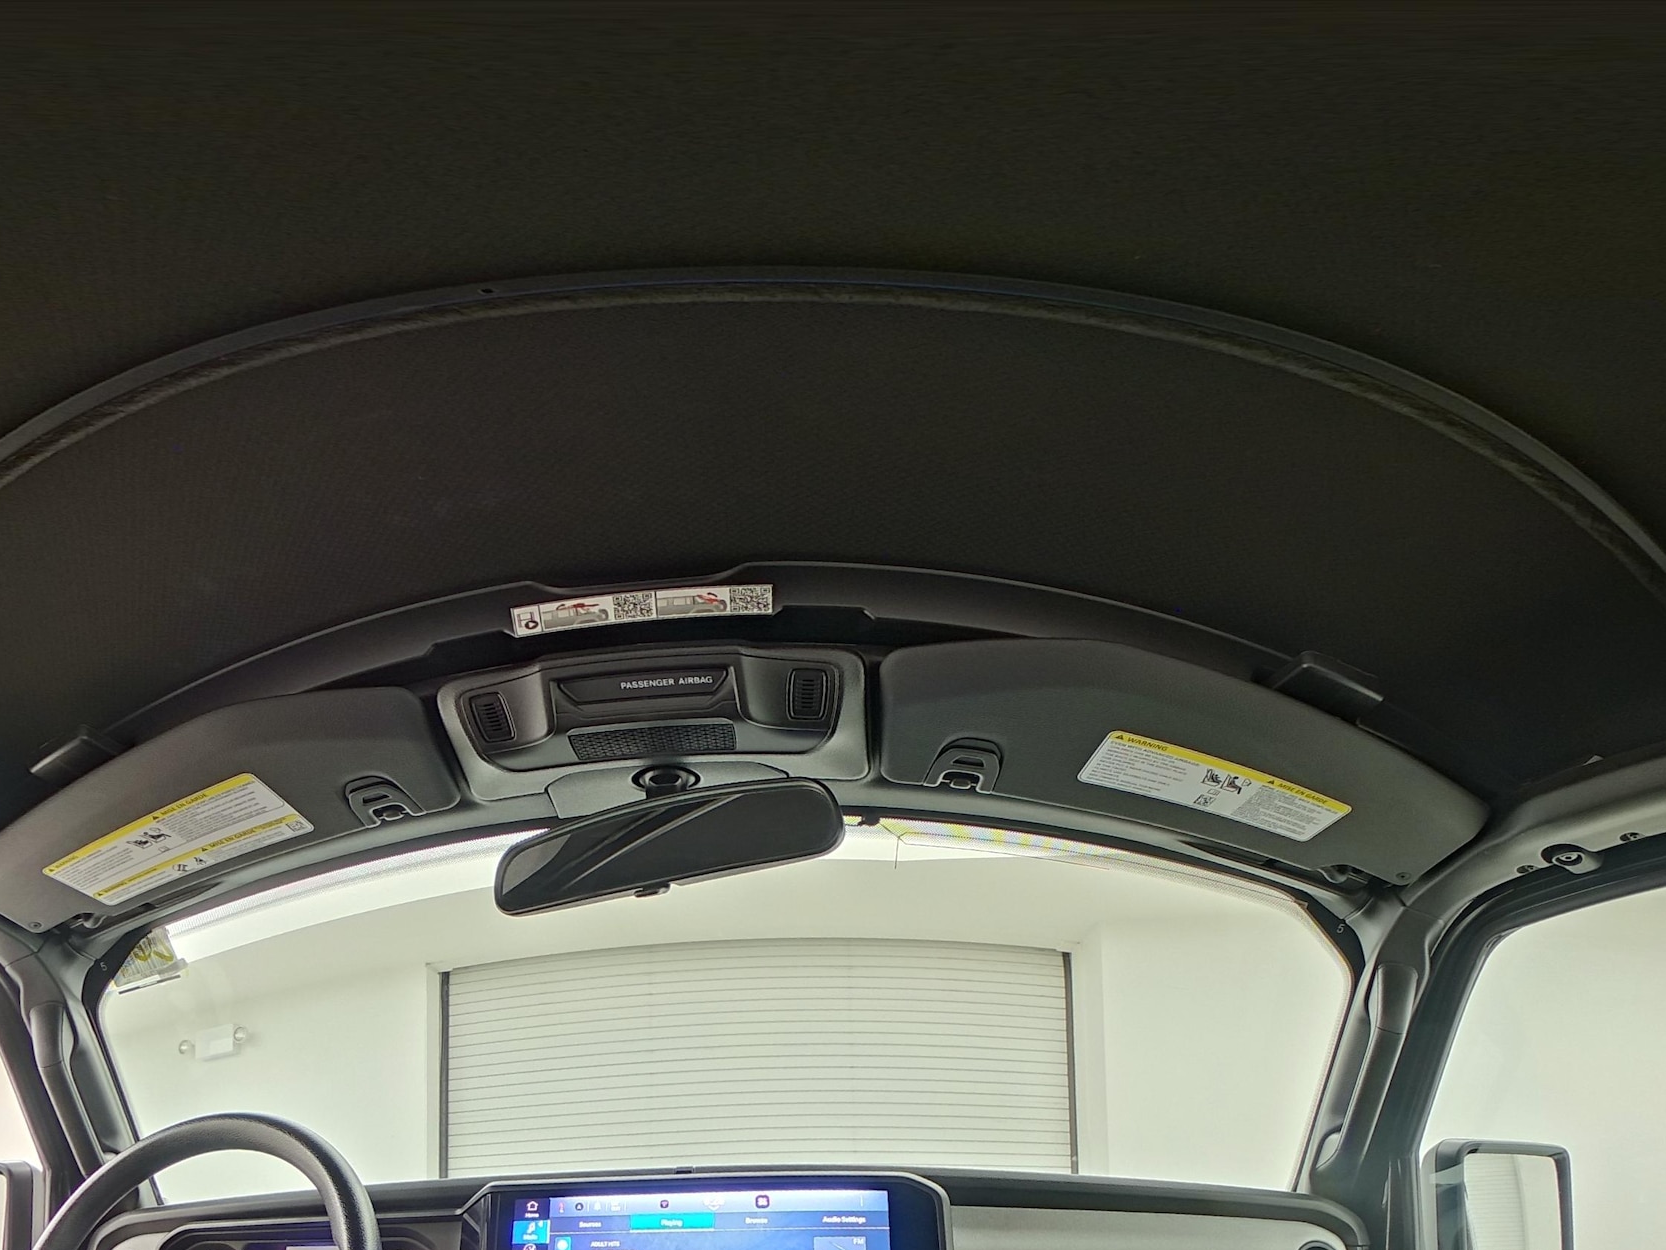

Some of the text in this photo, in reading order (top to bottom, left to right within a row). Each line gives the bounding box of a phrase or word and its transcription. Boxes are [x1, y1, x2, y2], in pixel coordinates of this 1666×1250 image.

[620, 676, 713, 690] PASSENGER AIRBAG
[1127, 736, 1168, 752] WARNING
[1336, 923, 1345, 934] 5
[100, 962, 108, 971] 5
[841, 1216, 866, 1224] Settings
